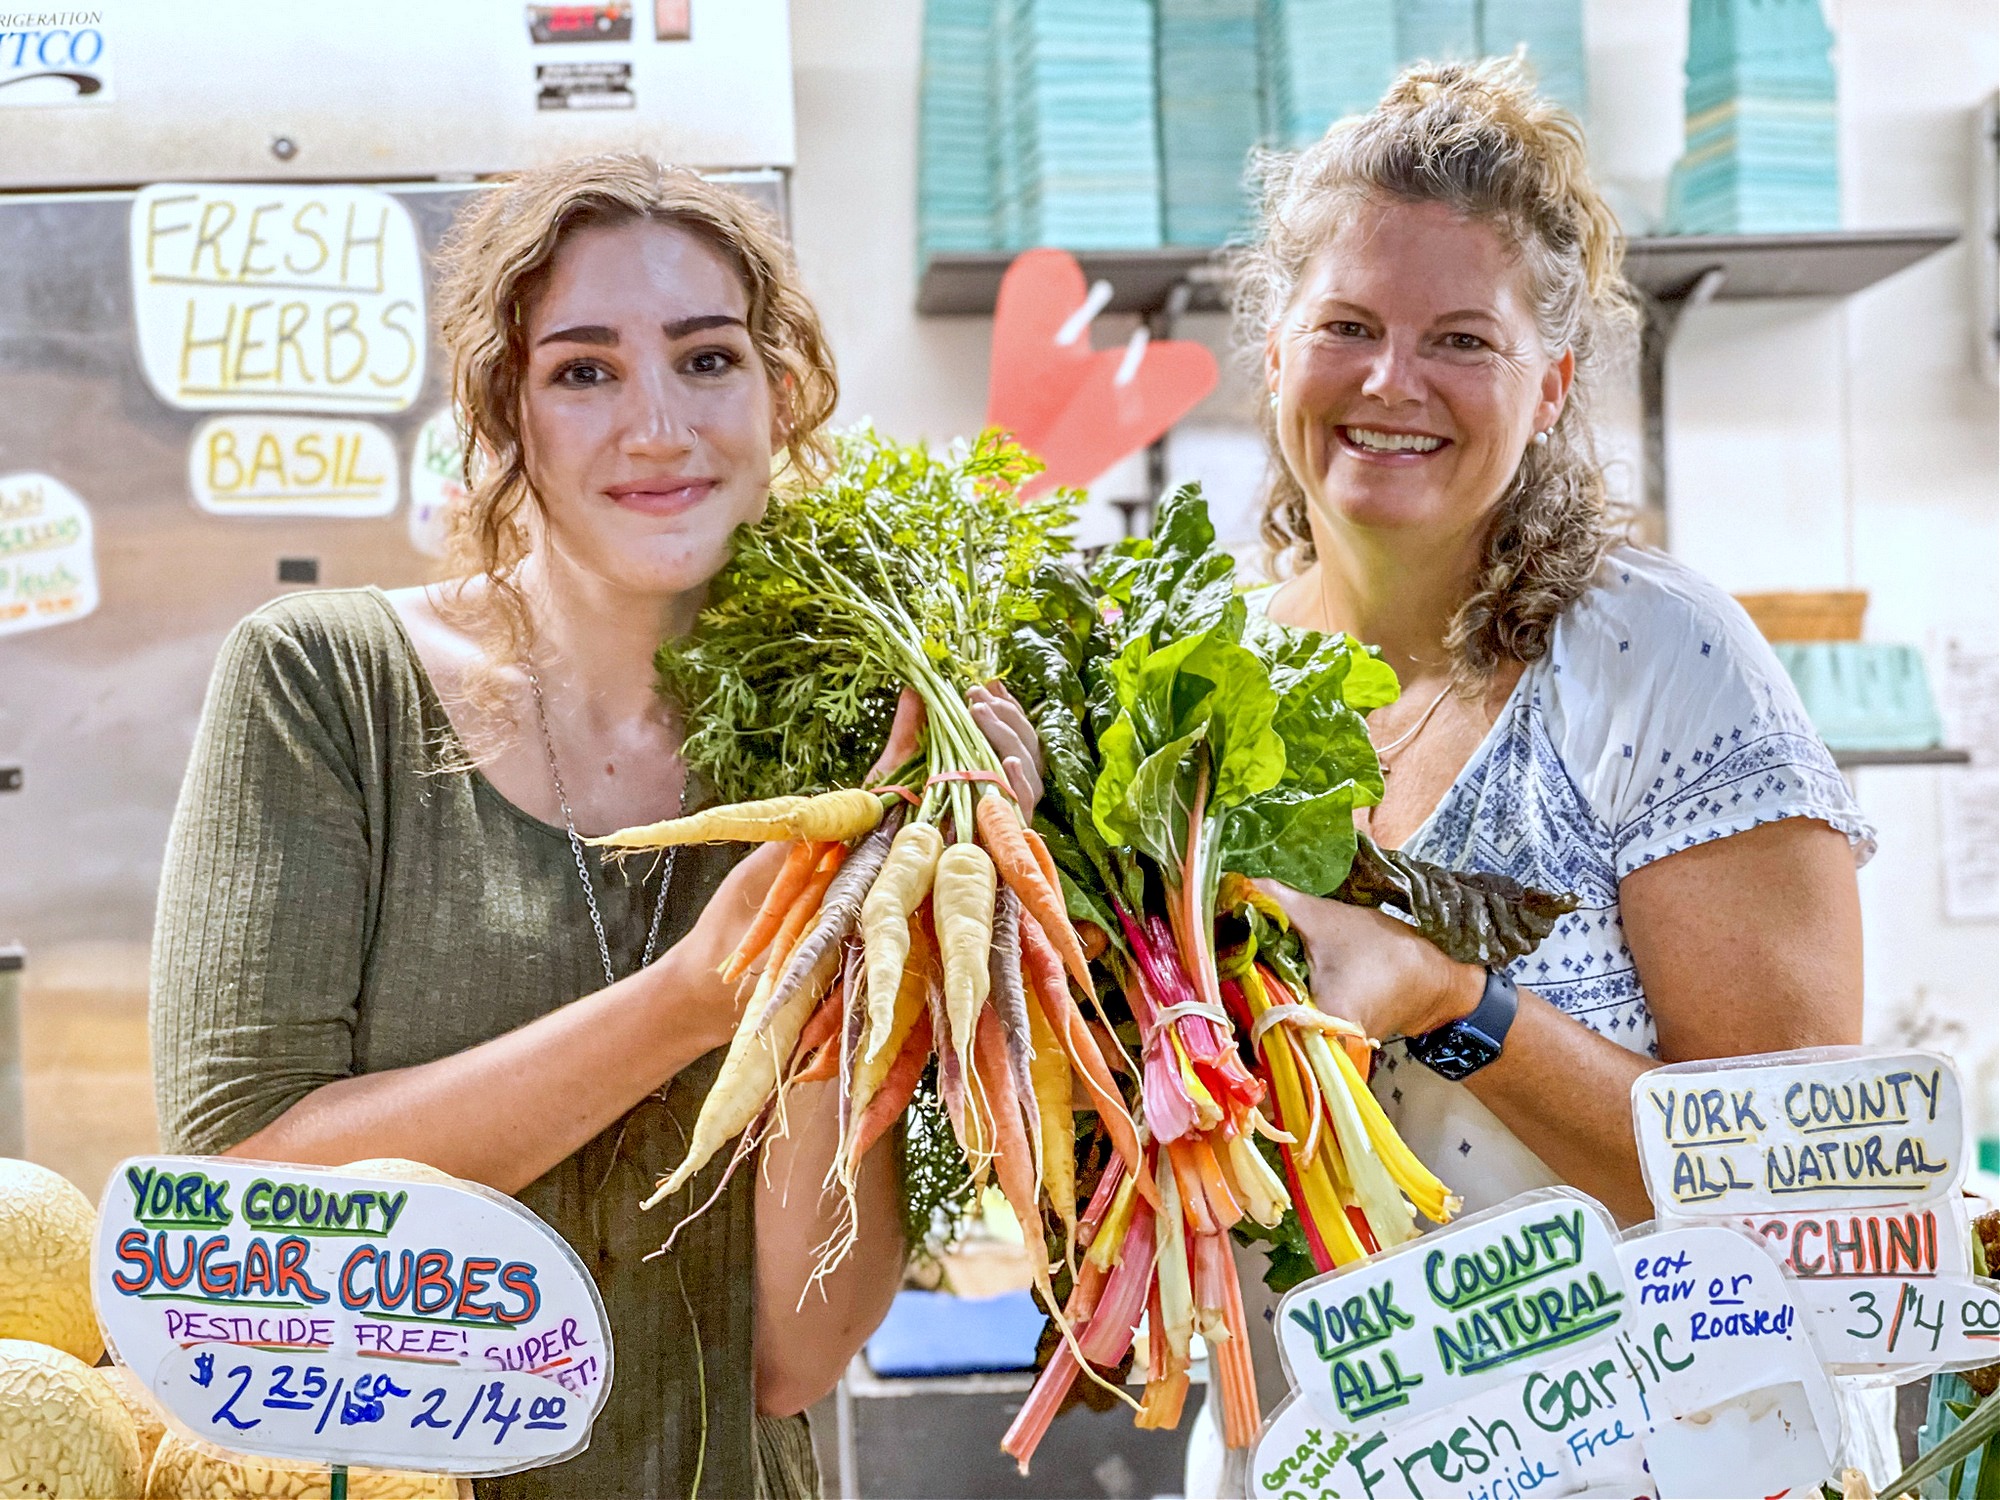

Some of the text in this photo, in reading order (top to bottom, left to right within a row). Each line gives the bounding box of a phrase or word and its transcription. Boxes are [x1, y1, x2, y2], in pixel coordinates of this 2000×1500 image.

[146, 195, 389, 290] FRESH
[180, 299, 416, 388] HERBS
[207, 430, 385, 493] BASIL
[1650, 1070, 1941, 1139] YORK COUNTY
[126, 1167, 408, 1229] YORK COUNTY
[1672, 1136, 1947, 1195] ALL NATURAL
[112, 1228, 541, 1324] SUGAR CUBES
[1634, 1250, 1692, 1280] eat
[1743, 1208, 1937, 1276] CHINI
[1289, 1208, 1584, 1356] YORK COUNTY
[1641, 1274, 1752, 1305] raw or
[164, 1308, 587, 1372] PESTICIDE FREE! SUPER
[1331, 1271, 1625, 1411] ALL NATURAL
[1346, 1323, 1694, 1500] Fresh Garlic
[1262, 1428, 1322, 1491] Great
